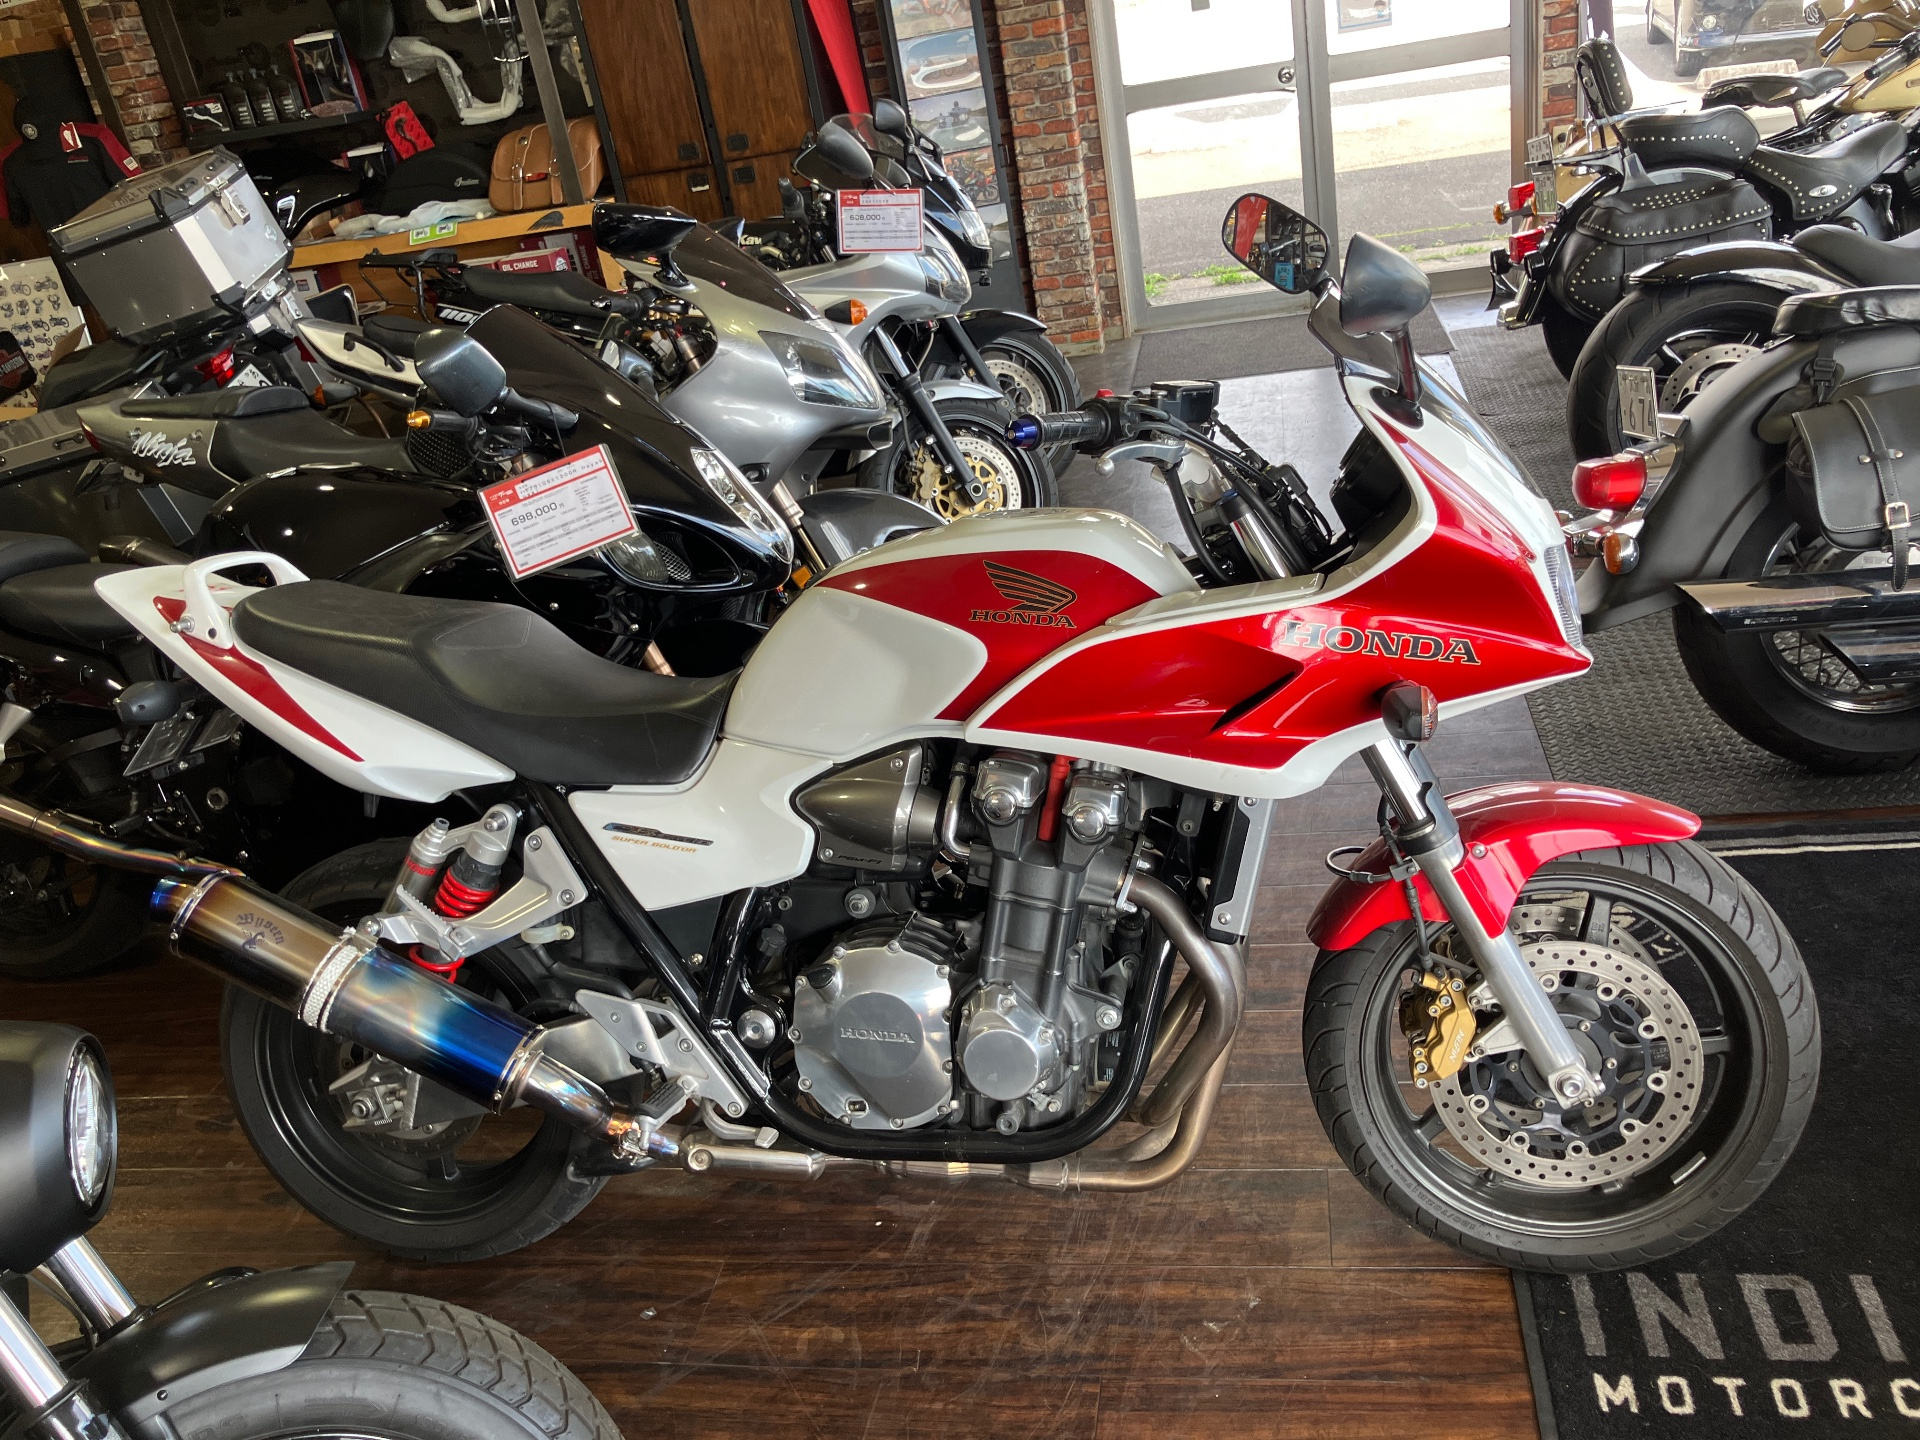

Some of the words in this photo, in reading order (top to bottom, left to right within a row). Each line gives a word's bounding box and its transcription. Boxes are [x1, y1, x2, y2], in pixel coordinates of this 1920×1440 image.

[502, 263, 513, 272] OIL
[513, 259, 538, 270] CHANGE
[132, 431, 197, 468] Ninja
[510, 501, 558, 527] 698,000
[968, 609, 1077, 629] HONDA
[1278, 619, 1481, 666] HONDA
[611, 835, 649, 846] SUPER
[840, 1027, 916, 1044] HONDA
[1568, 1272, 1909, 1364] INDI
